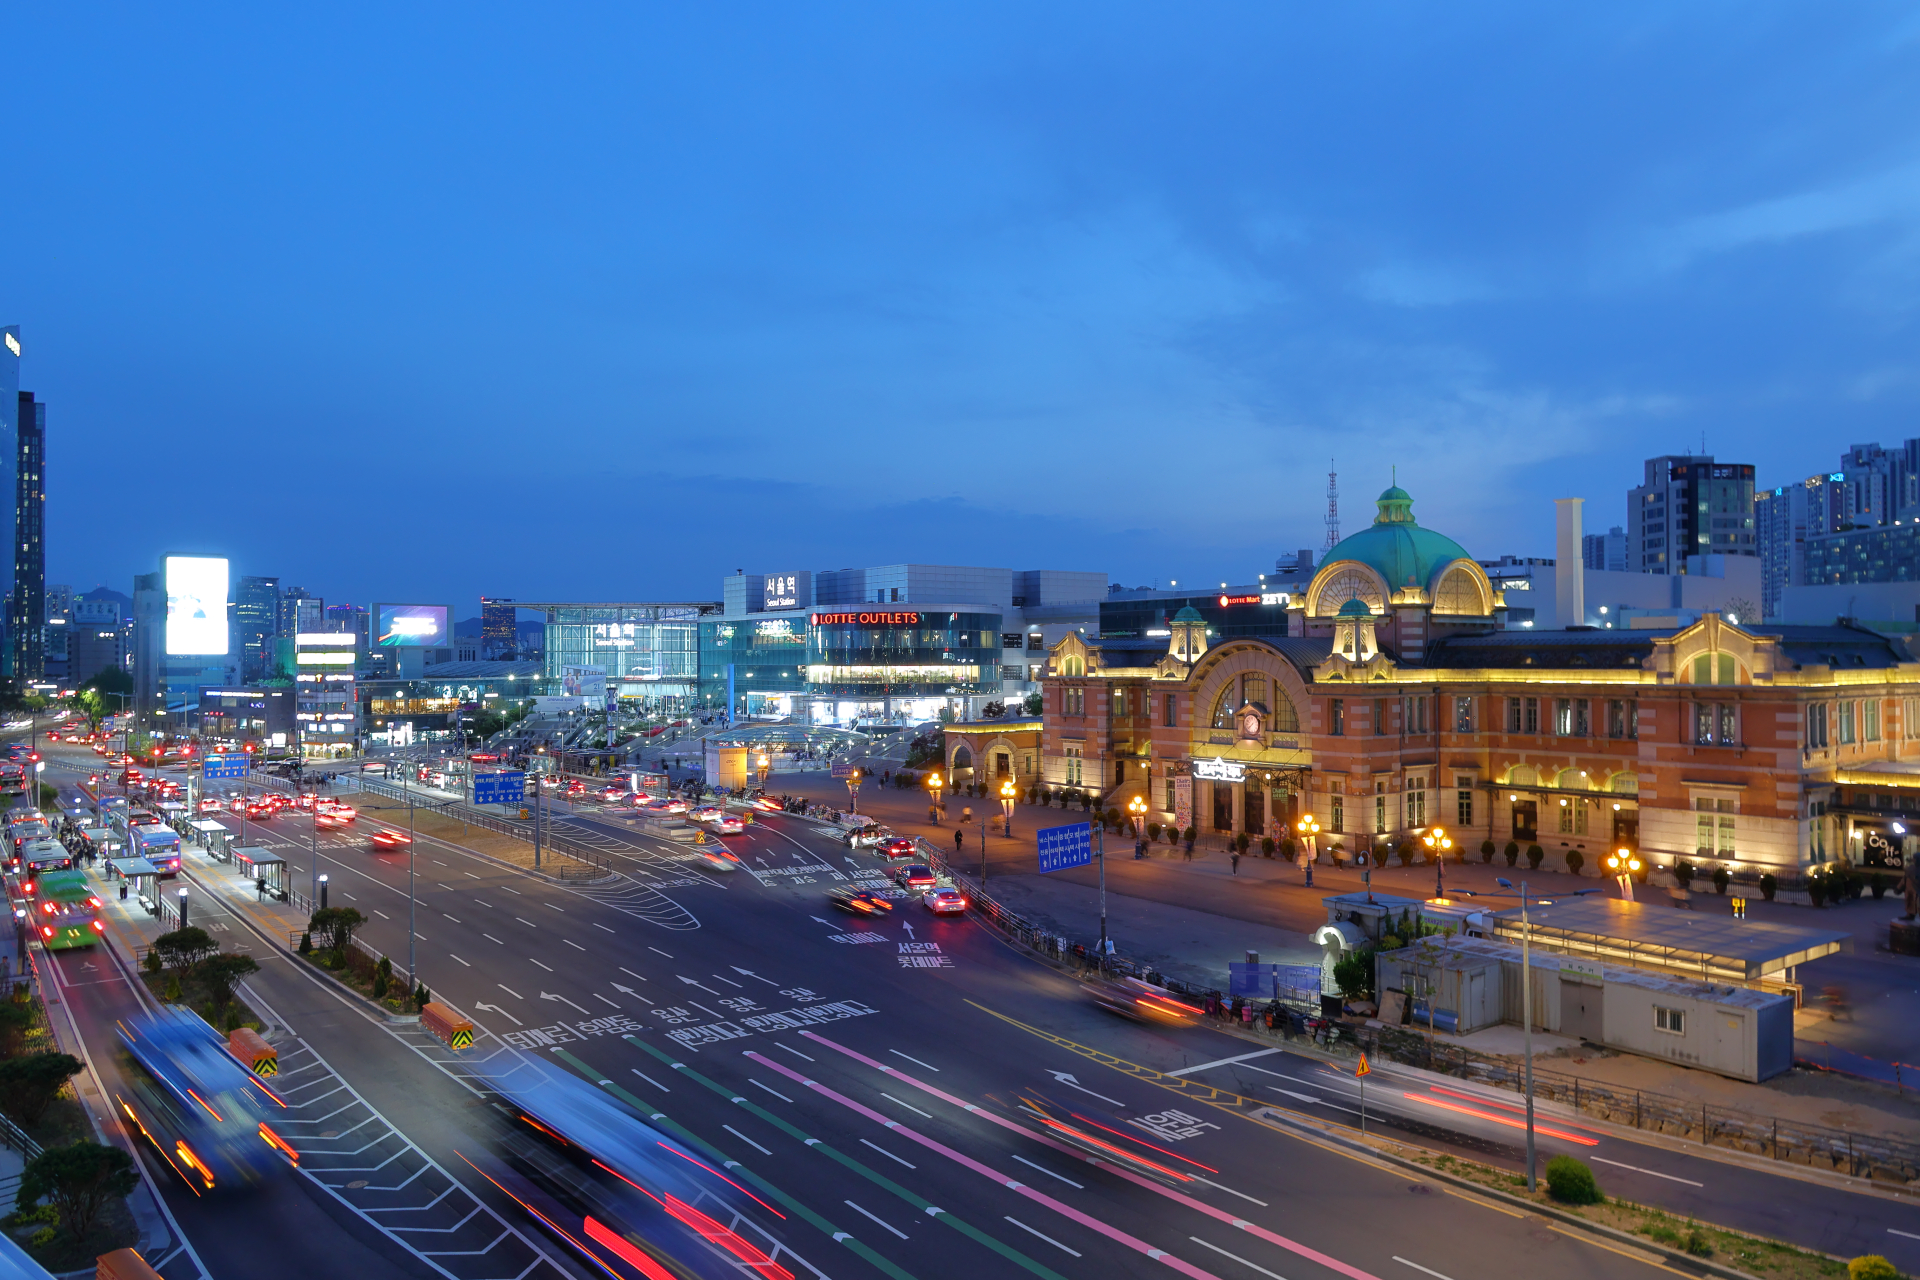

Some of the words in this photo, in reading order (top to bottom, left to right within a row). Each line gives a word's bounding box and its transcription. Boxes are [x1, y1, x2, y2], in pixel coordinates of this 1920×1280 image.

[766, 576, 796, 595] 서울역
[766, 599, 779, 607] Seoul
[779, 597, 796, 606] Station
[819, 613, 856, 625] LOTTE
[859, 612, 918, 624] OUTLETS
[595, 623, 635, 638] 서울역
[1869, 835, 1888, 848] Co
[849, 869, 886, 878] 서울역
[898, 942, 942, 954] 서울역
[897, 956, 956, 968] 롯데마트
[778, 987, 826, 1002] 용산
[718, 996, 767, 1013] 용산
[803, 1000, 880, 1023] 한강대교
[651, 1006, 700, 1024] 용산
[740, 1008, 820, 1033] 한강대교
[502, 1026, 577, 1051] 퇴계로
[670, 1021, 754, 1046] 한강대교
[1127, 1109, 1222, 1142] 서울역
